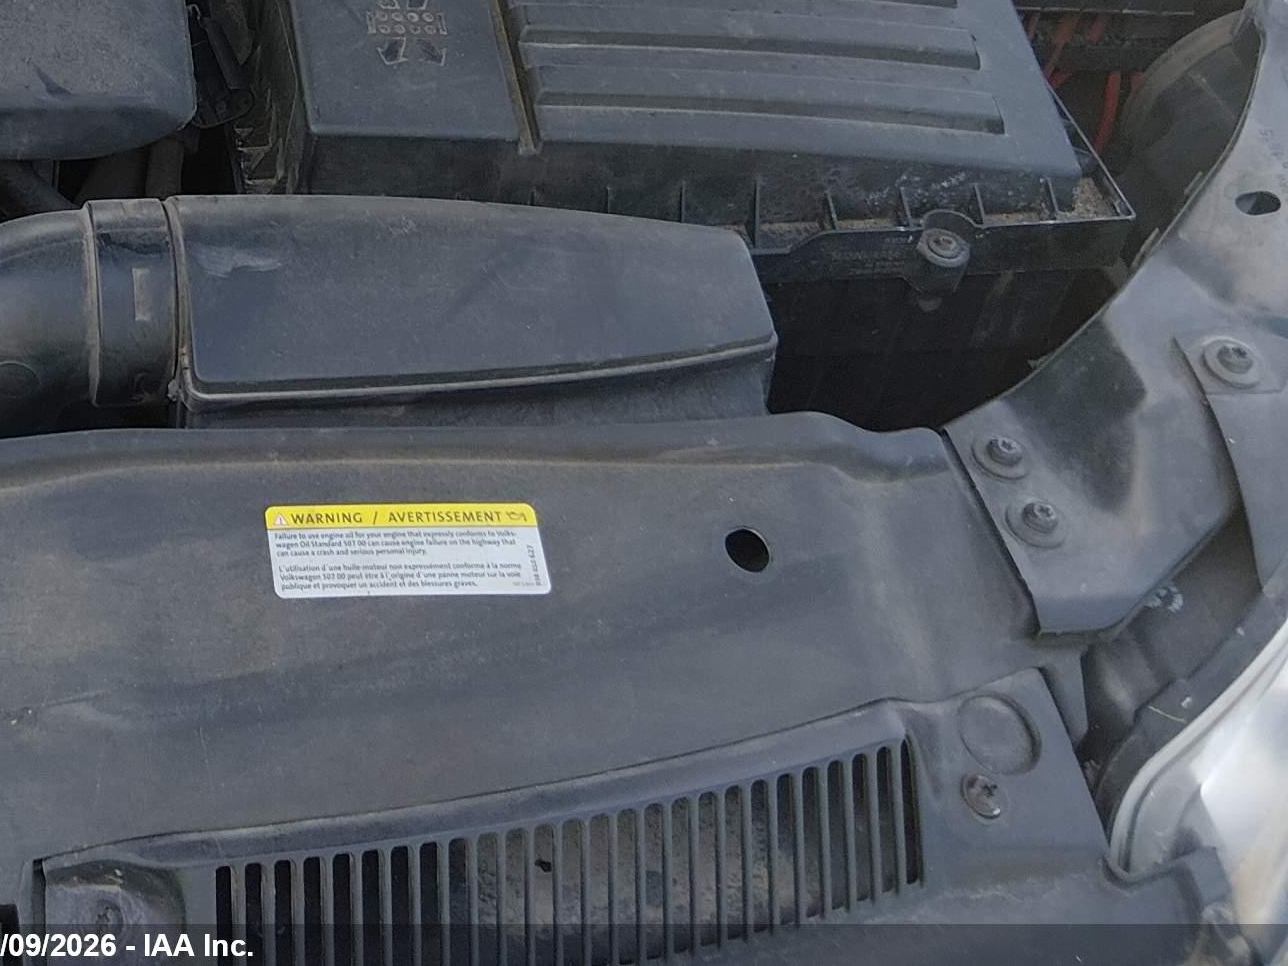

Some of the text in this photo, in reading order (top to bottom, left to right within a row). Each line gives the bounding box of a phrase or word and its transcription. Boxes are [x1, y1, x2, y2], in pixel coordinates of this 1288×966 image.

[291, 511, 502, 525] WARNING / AVERTISSEMENT
[275, 532, 297, 540] Failure
[321, 533, 343, 541] engine
[383, 532, 407, 540] engine
[407, 530, 422, 538] that
[423, 530, 454, 538] expressly
[276, 542, 298, 550] wagen
[401, 540, 425, 548] engine
[426, 538, 447, 546] failure
[472, 539, 501, 547] highway
[376, 547, 405, 556] personal
[280, 573, 321, 582] Volkswagen
[347, 572, 363, 581] peut
[438, 572, 459, 580] panne
[281, 583, 313, 592] publique
[322, 582, 357, 591] provoquer
[370, 580, 397, 588] accident
